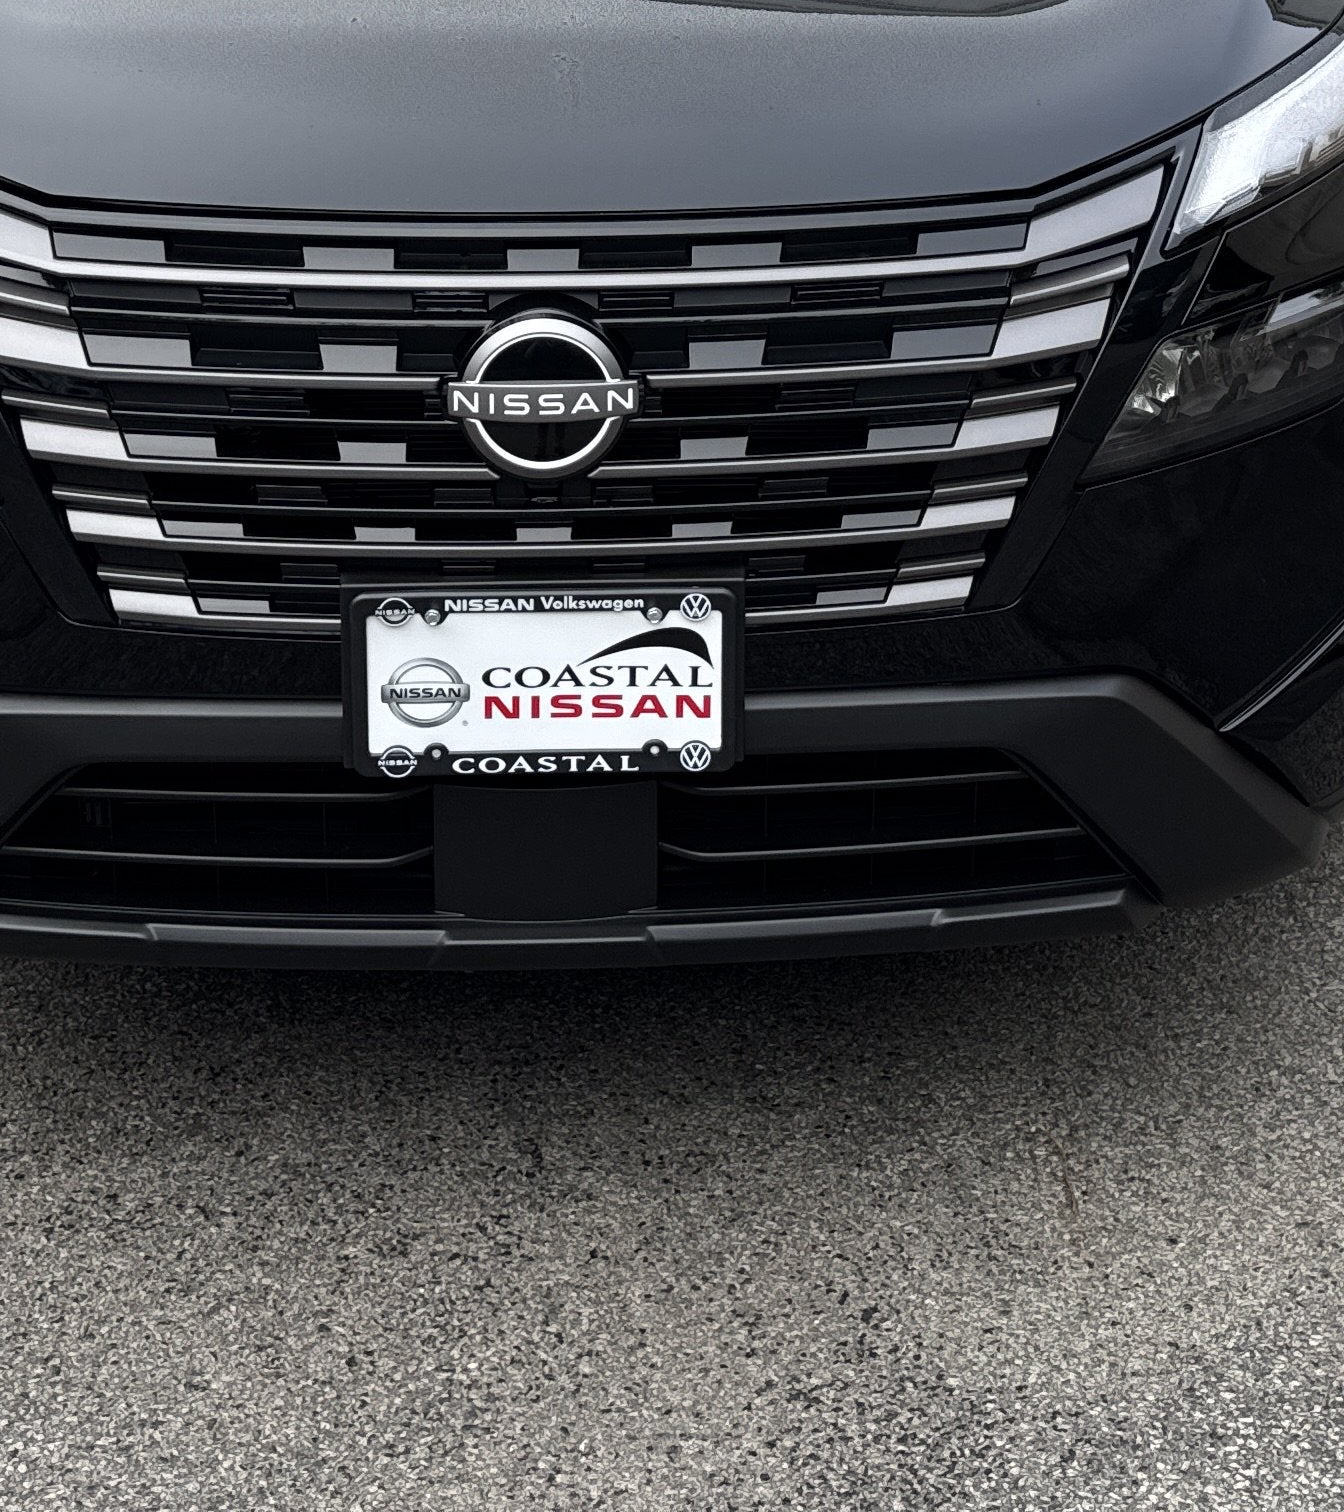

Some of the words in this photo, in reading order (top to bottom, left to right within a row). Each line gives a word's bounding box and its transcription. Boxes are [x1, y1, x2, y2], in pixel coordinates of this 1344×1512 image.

[453, 388, 635, 415] NISSAN
[375, 606, 416, 617] NISSAN
[444, 598, 535, 612] NISSAN
[540, 595, 645, 610] Volkswagen
[482, 664, 713, 688] COASTAL
[390, 687, 462, 700] NISSAN
[484, 694, 712, 719] NISSAN
[377, 758, 419, 768] NISSAN
[452, 755, 640, 775] COASTAL
